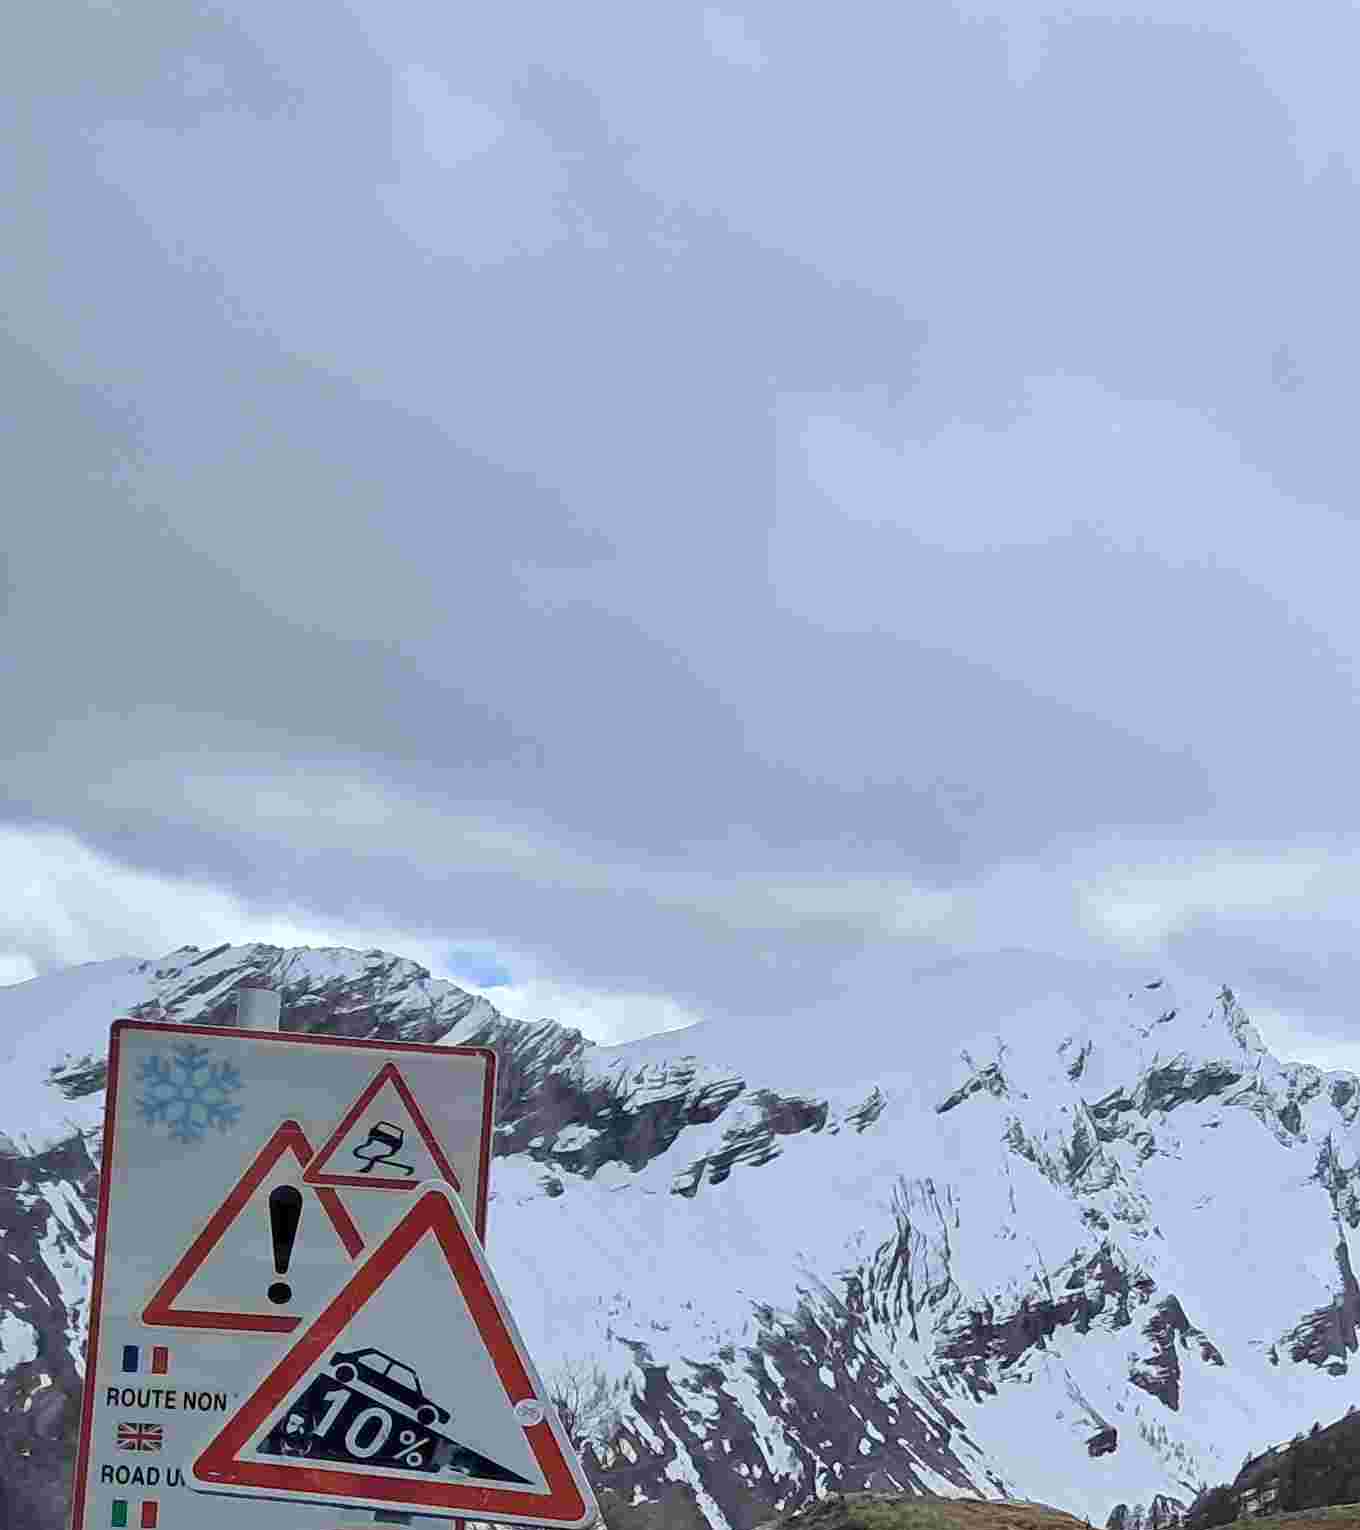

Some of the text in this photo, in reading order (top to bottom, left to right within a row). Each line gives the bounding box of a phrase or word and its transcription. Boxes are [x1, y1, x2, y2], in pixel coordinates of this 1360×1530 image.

[106, 1387, 227, 1412] ROUTE NON
[311, 1388, 431, 1468] 10%
[101, 1464, 161, 1486] ROAD
